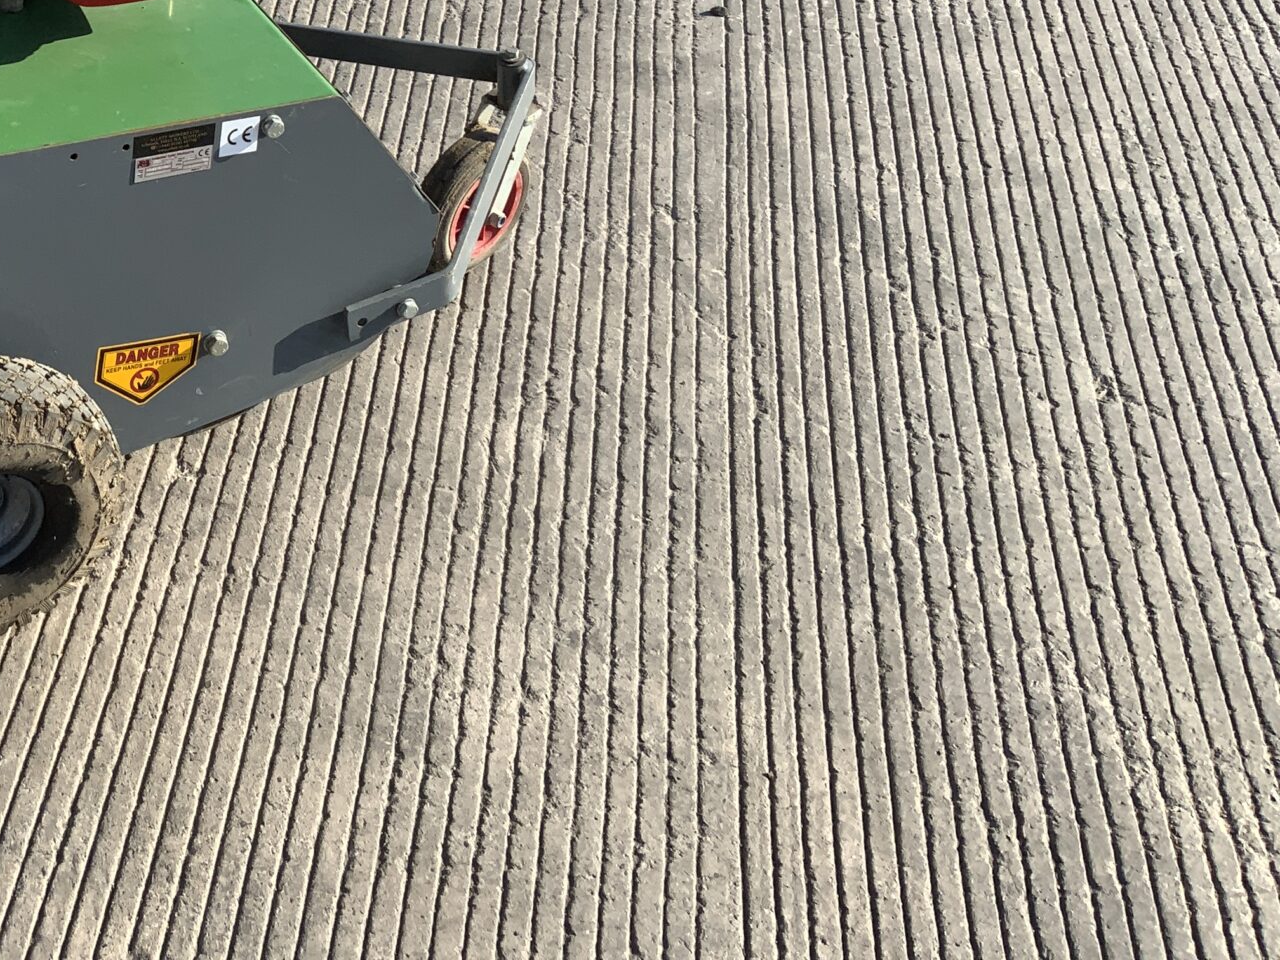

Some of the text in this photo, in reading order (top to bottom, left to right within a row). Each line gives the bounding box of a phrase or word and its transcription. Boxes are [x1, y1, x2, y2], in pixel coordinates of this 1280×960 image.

[227, 126, 253, 146] CE
[115, 343, 180, 366] DANGER
[105, 366, 122, 374] KEEP
[122, 363, 142, 371] HANDS
